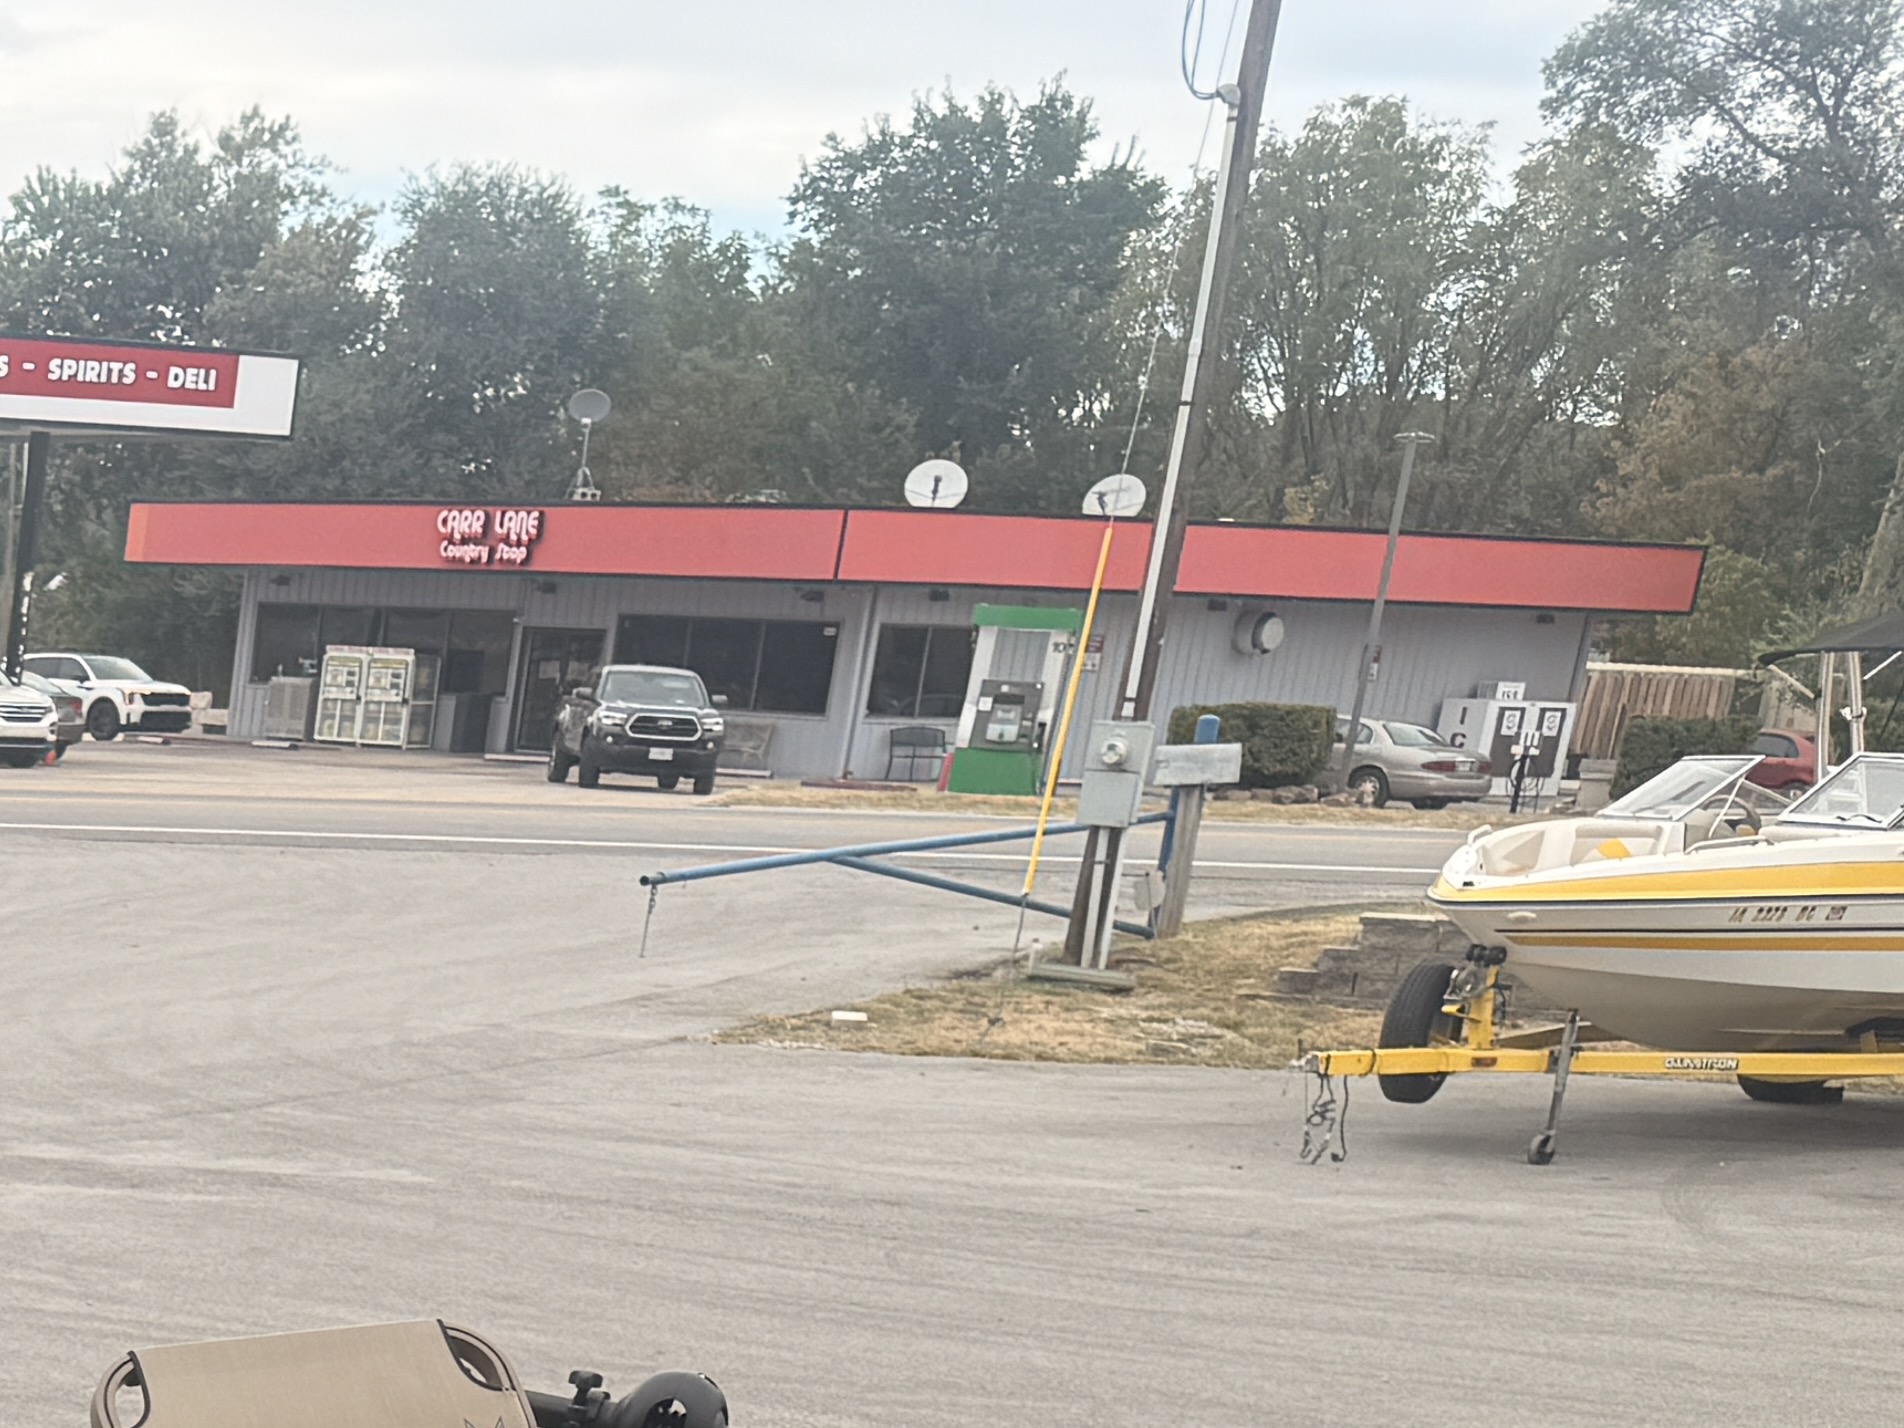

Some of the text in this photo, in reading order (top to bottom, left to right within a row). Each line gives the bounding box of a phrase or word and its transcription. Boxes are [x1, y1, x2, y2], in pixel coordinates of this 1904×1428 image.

[47, 357, 137, 385] SPIRITS
[166, 365, 218, 392] DELI
[437, 509, 541, 541] CARR LANE
[440, 540, 490, 563] Country
